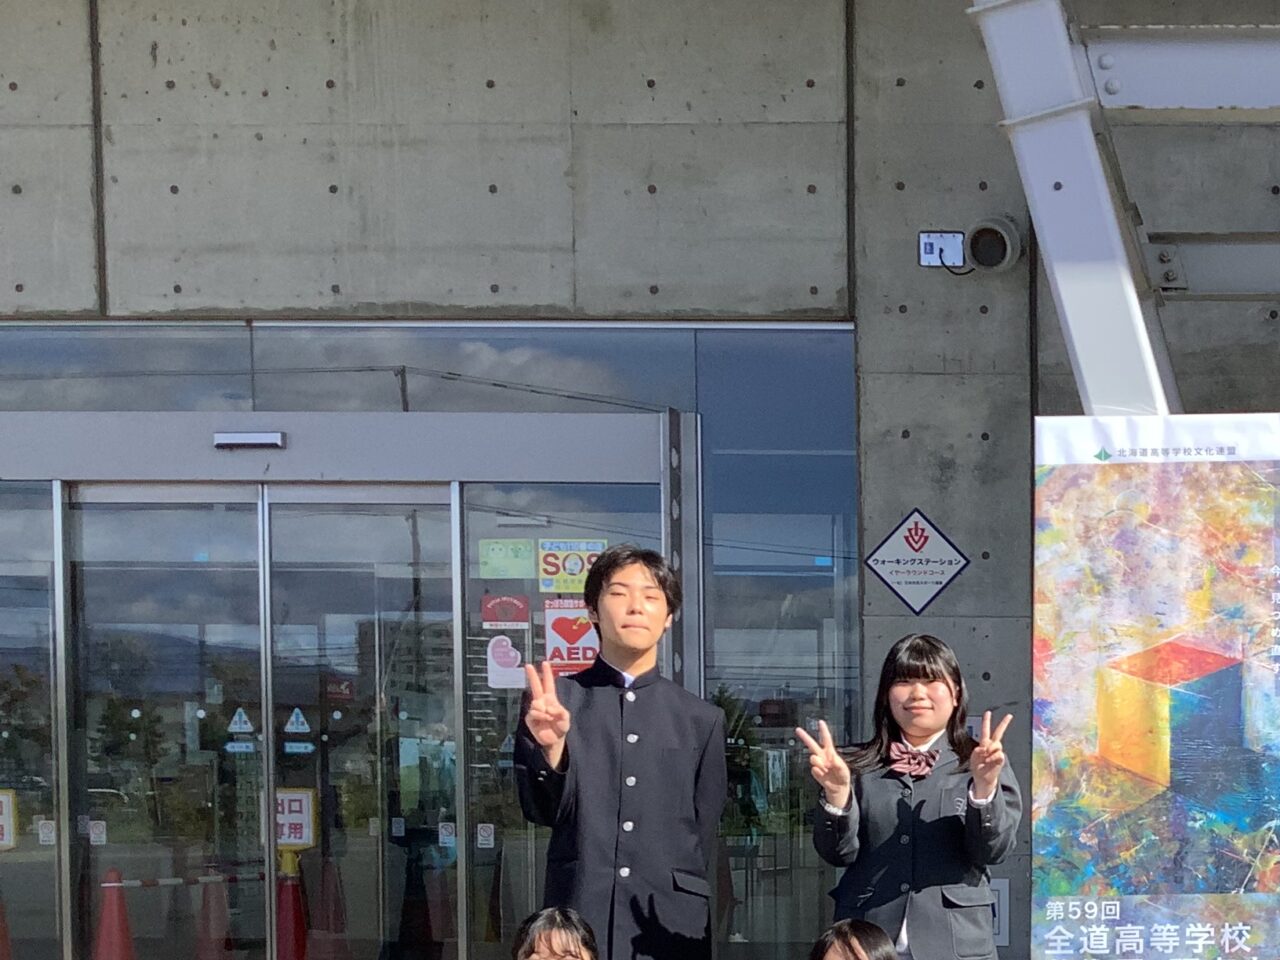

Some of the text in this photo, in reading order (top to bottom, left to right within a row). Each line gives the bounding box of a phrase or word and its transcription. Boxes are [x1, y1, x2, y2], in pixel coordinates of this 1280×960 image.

[1117, 446, 1237, 457] 北海道高等学校文化連盟
[872, 558, 961, 566] ウォーキングステーション
[549, 646, 597, 661] AED
[1045, 901, 1121, 921] 第59回
[1044, 923, 1252, 955] 全道高等学校
